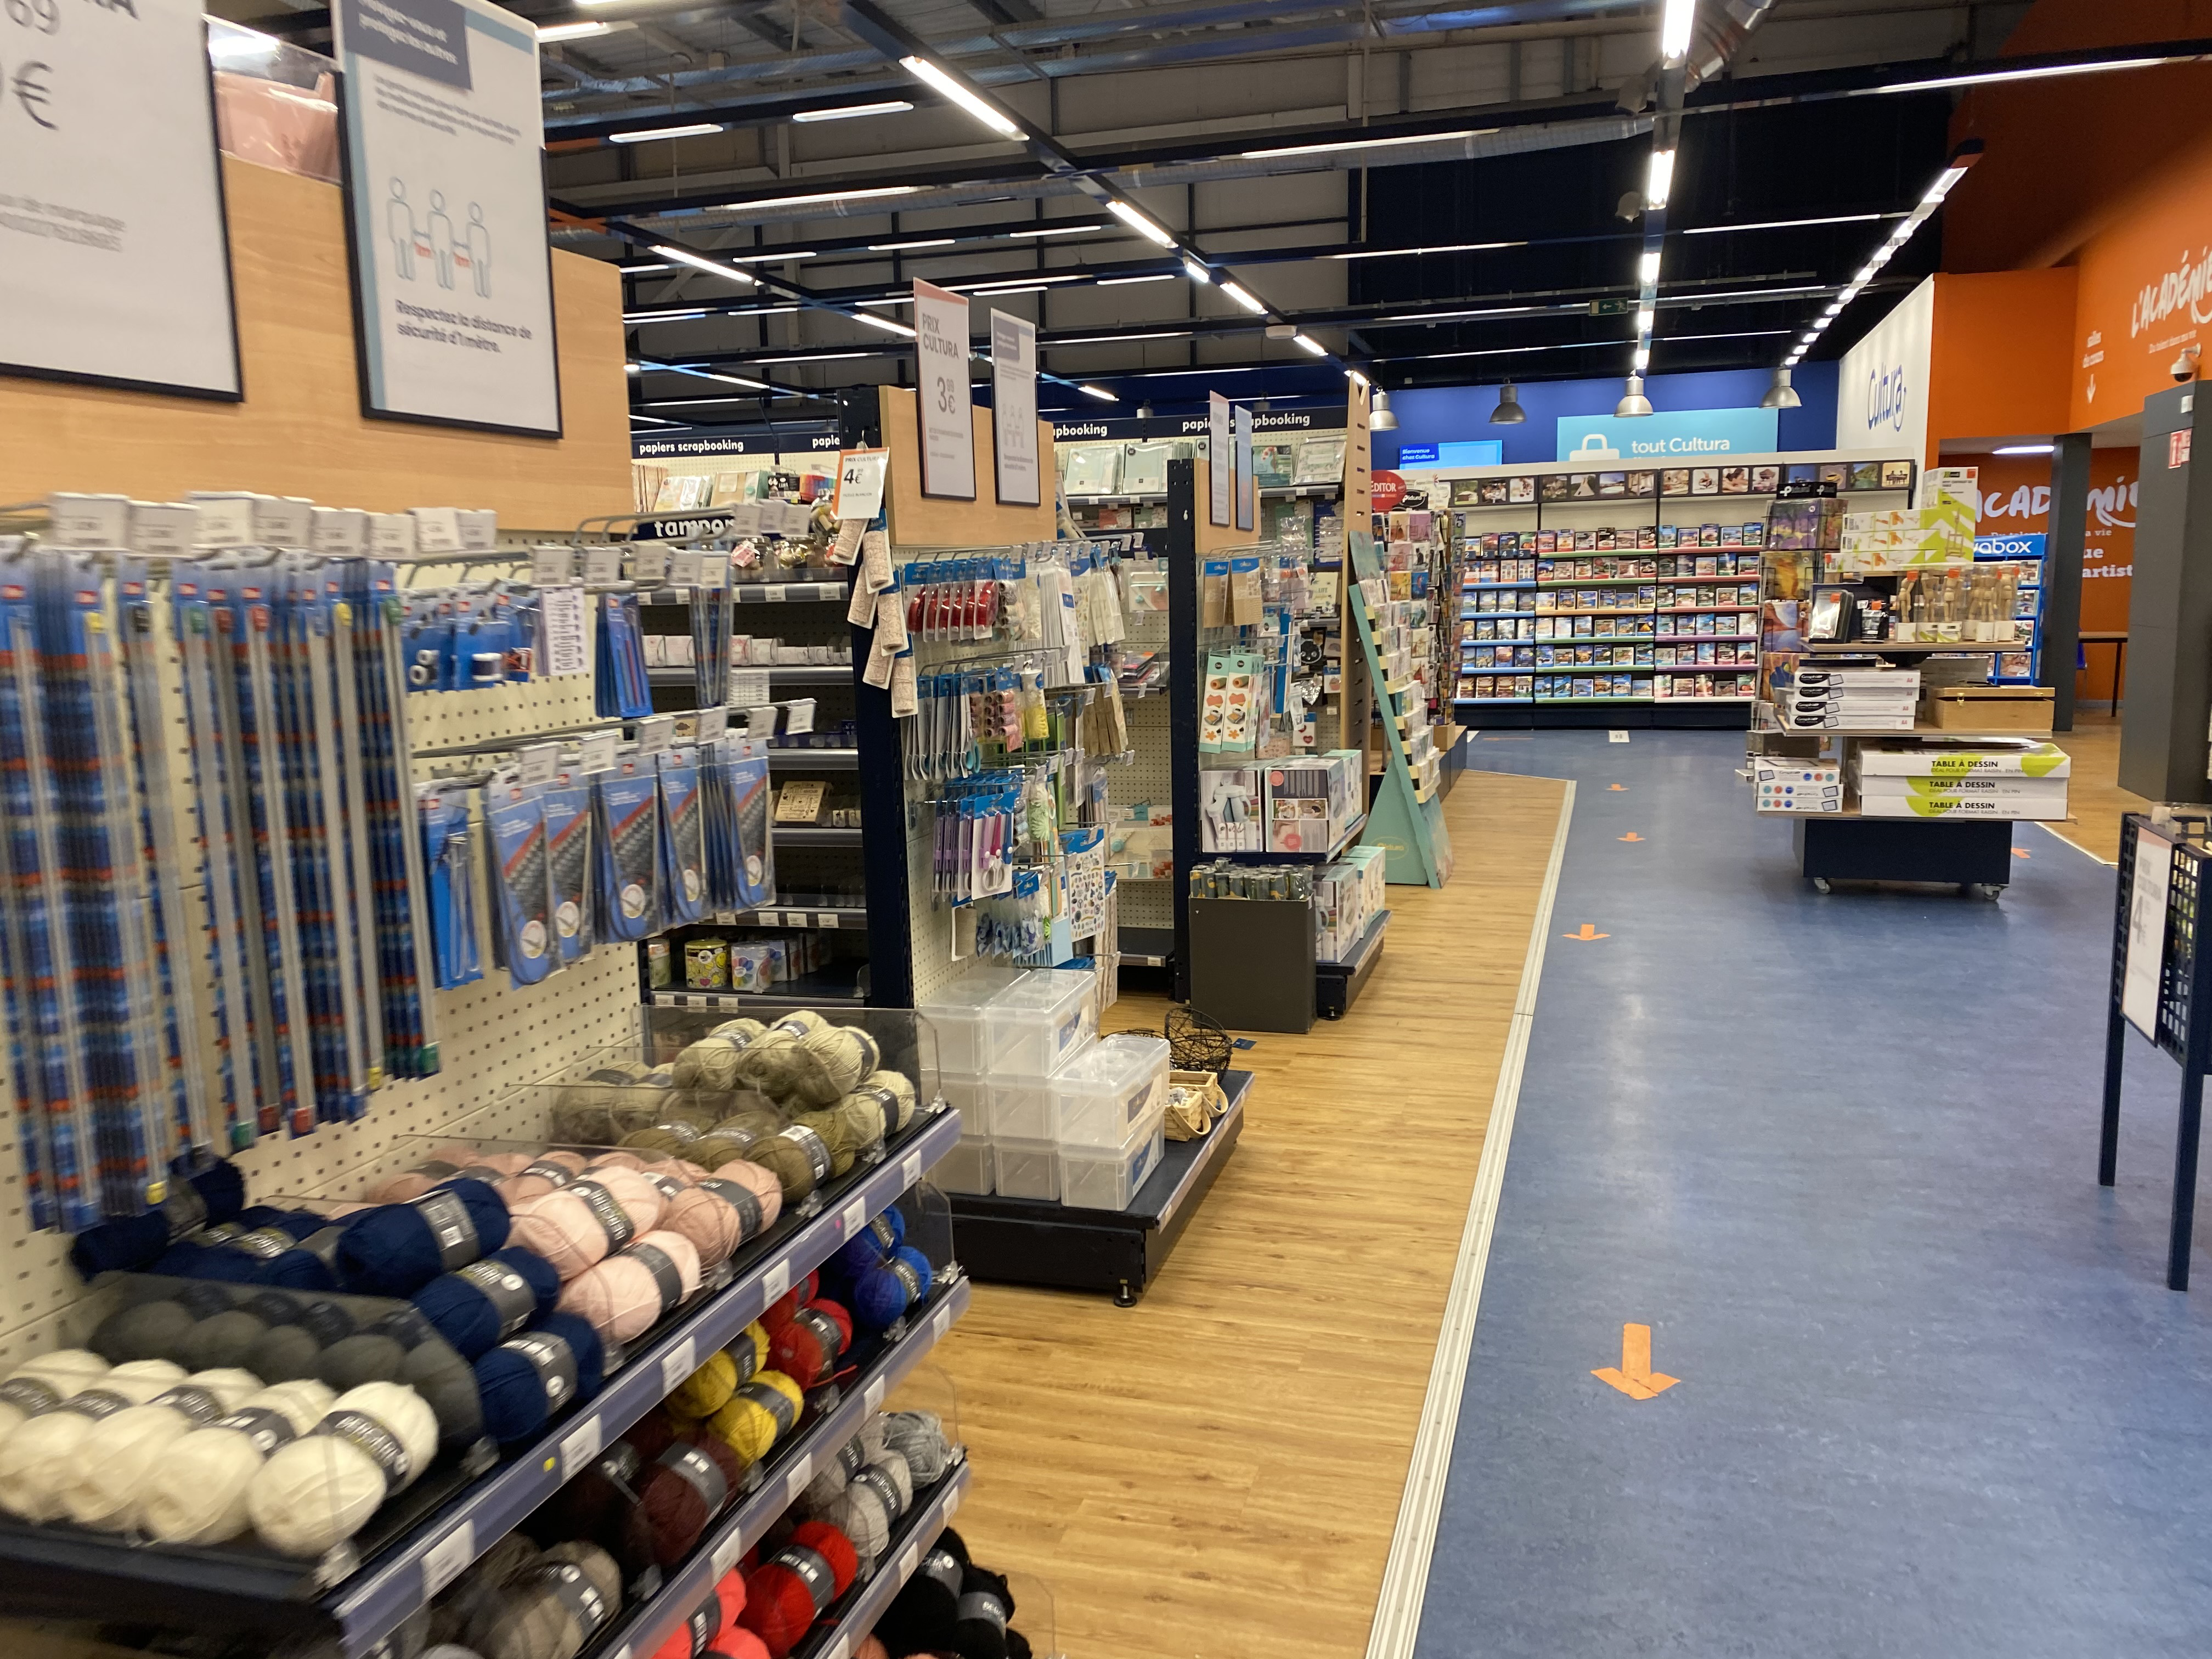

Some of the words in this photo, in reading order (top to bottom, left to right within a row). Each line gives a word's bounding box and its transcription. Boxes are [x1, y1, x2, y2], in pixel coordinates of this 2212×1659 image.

[922, 313, 940, 335] PRIX
[923, 333, 960, 359] CULTURA
[937, 377, 947, 413] 3
[948, 394, 956, 414] €
[1053, 423, 1107, 439] pbooking
[1182, 417, 1211, 432] papi
[639, 442, 675, 455] papiers
[678, 438, 744, 454] scrapbooking
[812, 435, 840, 449] papie
[1632, 439, 1667, 454] tout
[1669, 436, 1730, 453] Cultura
[844, 469, 854, 484] 4
[2082, 564, 2133, 578] artist
